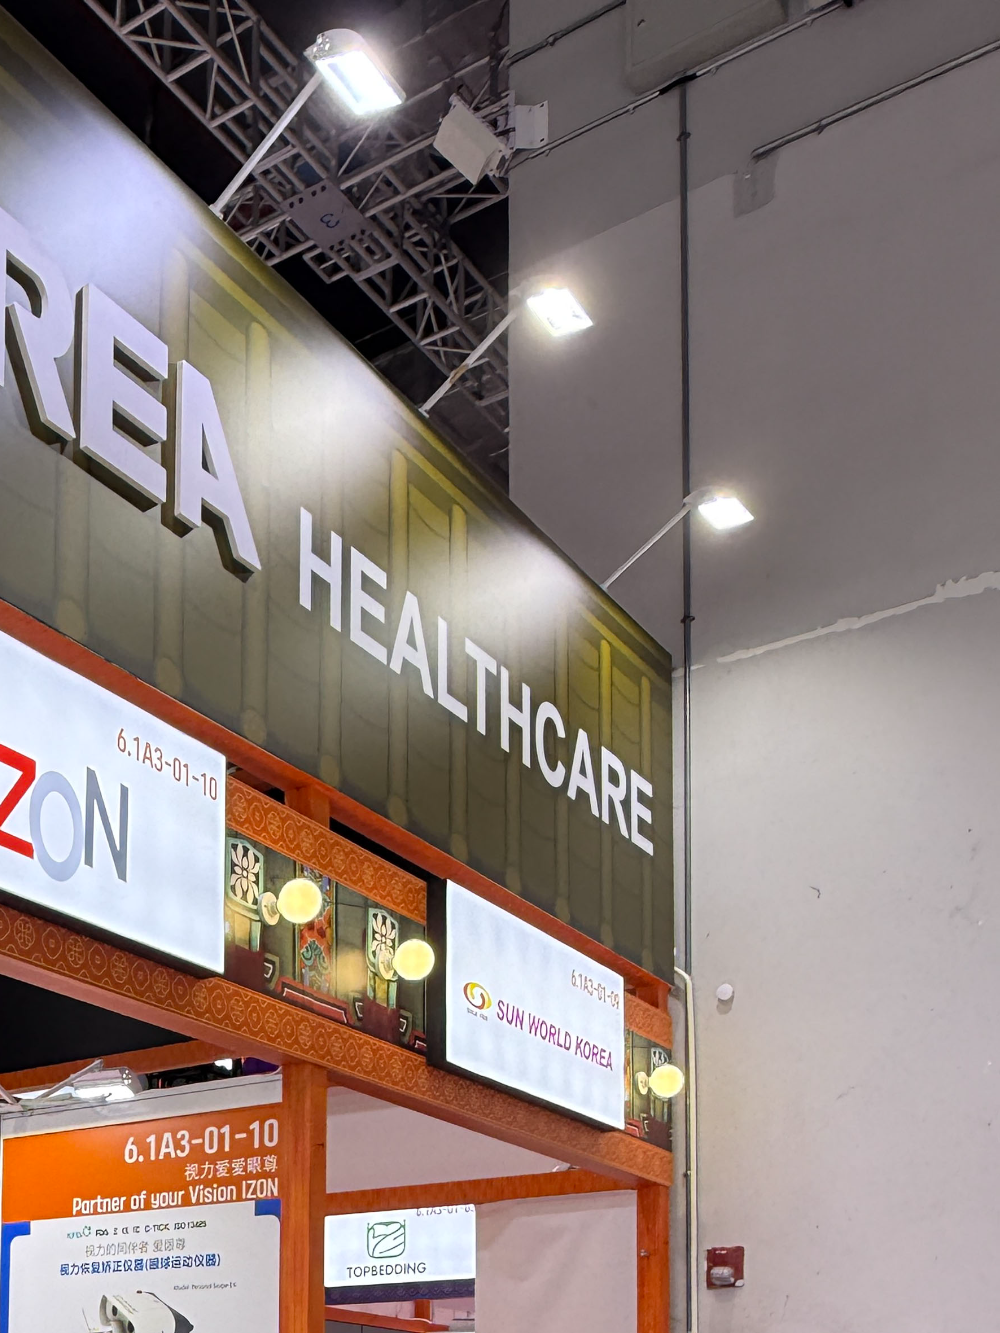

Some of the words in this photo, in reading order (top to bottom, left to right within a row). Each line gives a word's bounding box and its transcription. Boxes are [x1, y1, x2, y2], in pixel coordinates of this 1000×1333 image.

[300, 507, 654, 857] HEALTHCARE
[116, 728, 219, 801] 6.1A3-01-10
[496, 999, 525, 1031] SUN
[528, 1012, 572, 1051] WORLD
[575, 1035, 613, 1071] KOREA
[123, 1118, 279, 1165] 6.1A3-01-10
[72, 1195, 127, 1216] Partner
[130, 1190, 148, 1210] of
[151, 1189, 185, 1209] your
[189, 1183, 237, 1204] Vision
[242, 1178, 279, 1200] IZON
[346, 1261, 427, 1279] TOPBEDDING
